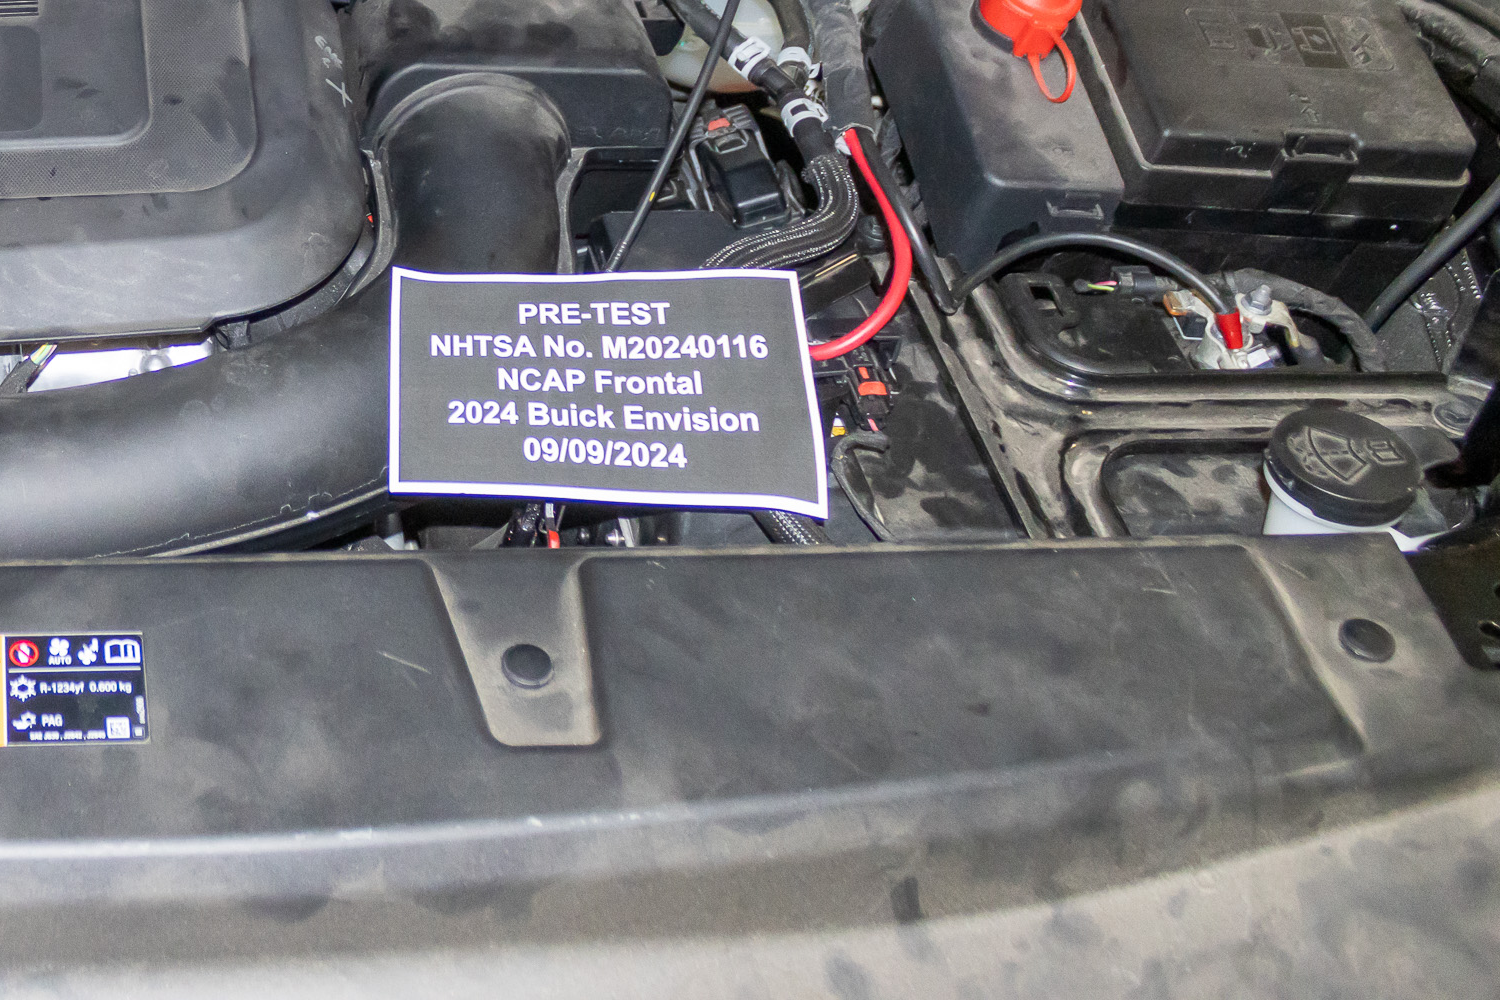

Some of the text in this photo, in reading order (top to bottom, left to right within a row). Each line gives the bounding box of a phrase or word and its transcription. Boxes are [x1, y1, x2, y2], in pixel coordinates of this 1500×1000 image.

[518, 302, 671, 326] PRE-TEST
[430, 334, 769, 360] NHTSA No. M20240116
[497, 367, 703, 395] NCAP Frontal
[447, 400, 760, 432] 2024 Buick Envision
[523, 437, 688, 469] 09/09/2024
[48, 655, 72, 666] AUTO
[39, 681, 133, 695] R-1234yf 0.600 kg
[41, 713, 63, 728] PAG
